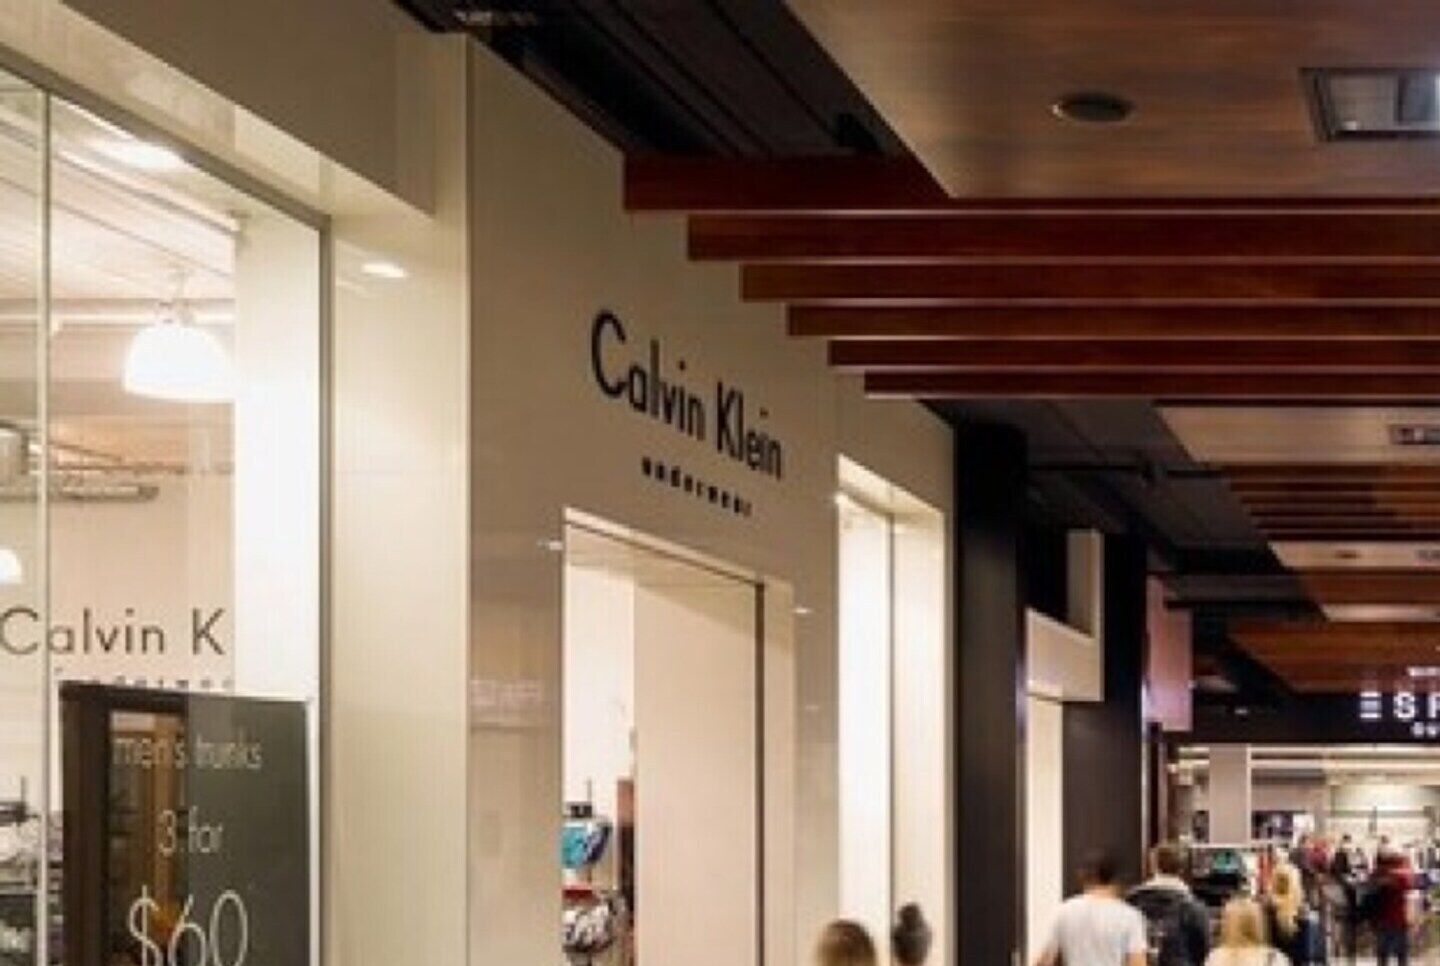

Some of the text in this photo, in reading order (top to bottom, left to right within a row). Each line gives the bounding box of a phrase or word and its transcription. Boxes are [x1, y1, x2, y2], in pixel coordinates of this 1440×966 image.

[591, 309, 783, 481] Calvin Klein
[0, 606, 165, 655] Calvin
[157, 804, 223, 856] 3 for
